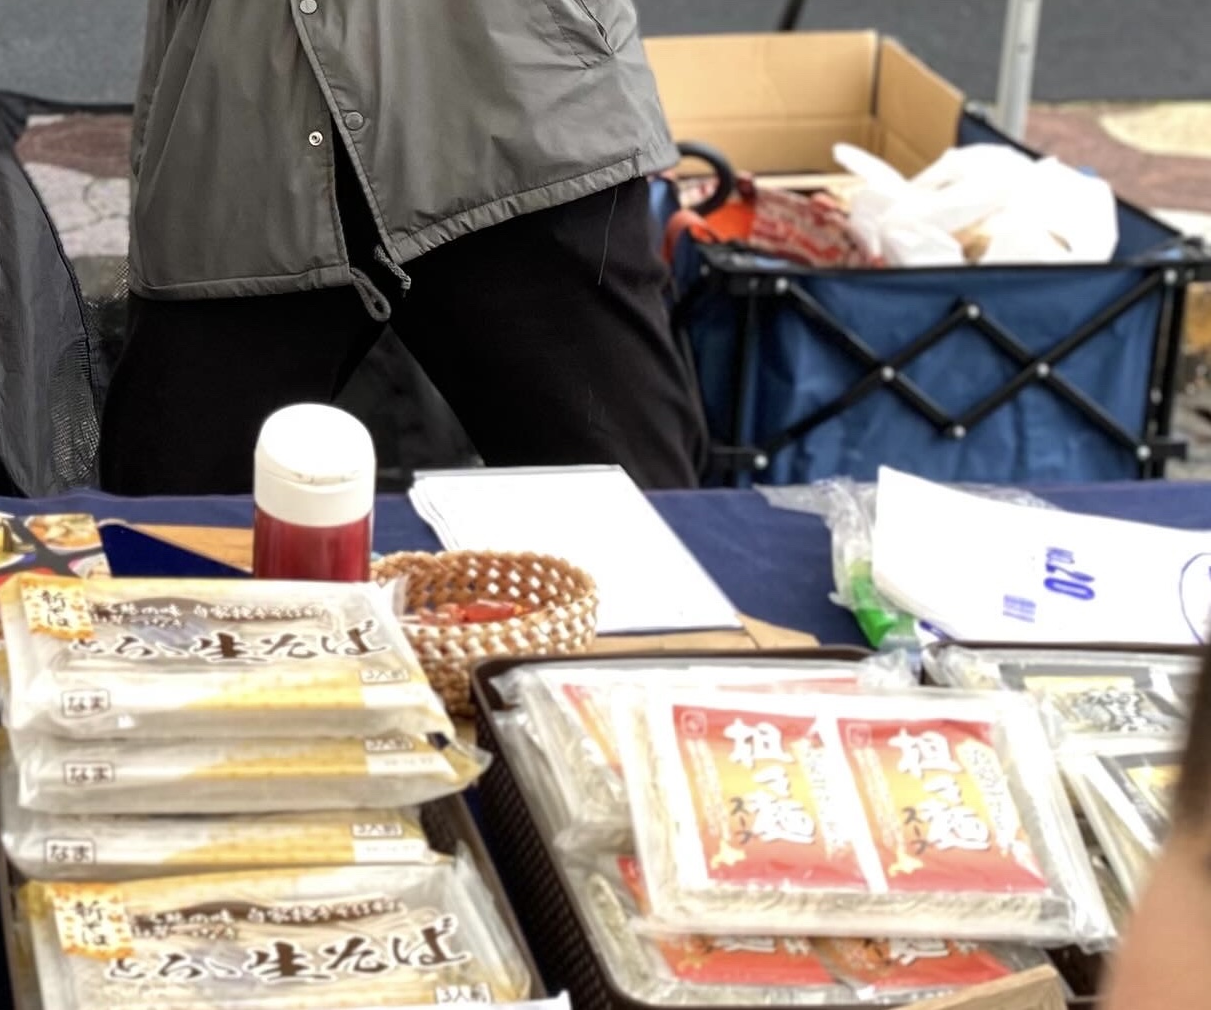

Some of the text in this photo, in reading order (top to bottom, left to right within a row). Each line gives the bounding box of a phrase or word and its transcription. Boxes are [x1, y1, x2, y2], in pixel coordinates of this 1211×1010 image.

[67, 695, 107, 712] なま
[69, 765, 113, 782] なま
[48, 844, 94, 863] なま
[74, 897, 112, 949] 新そば
